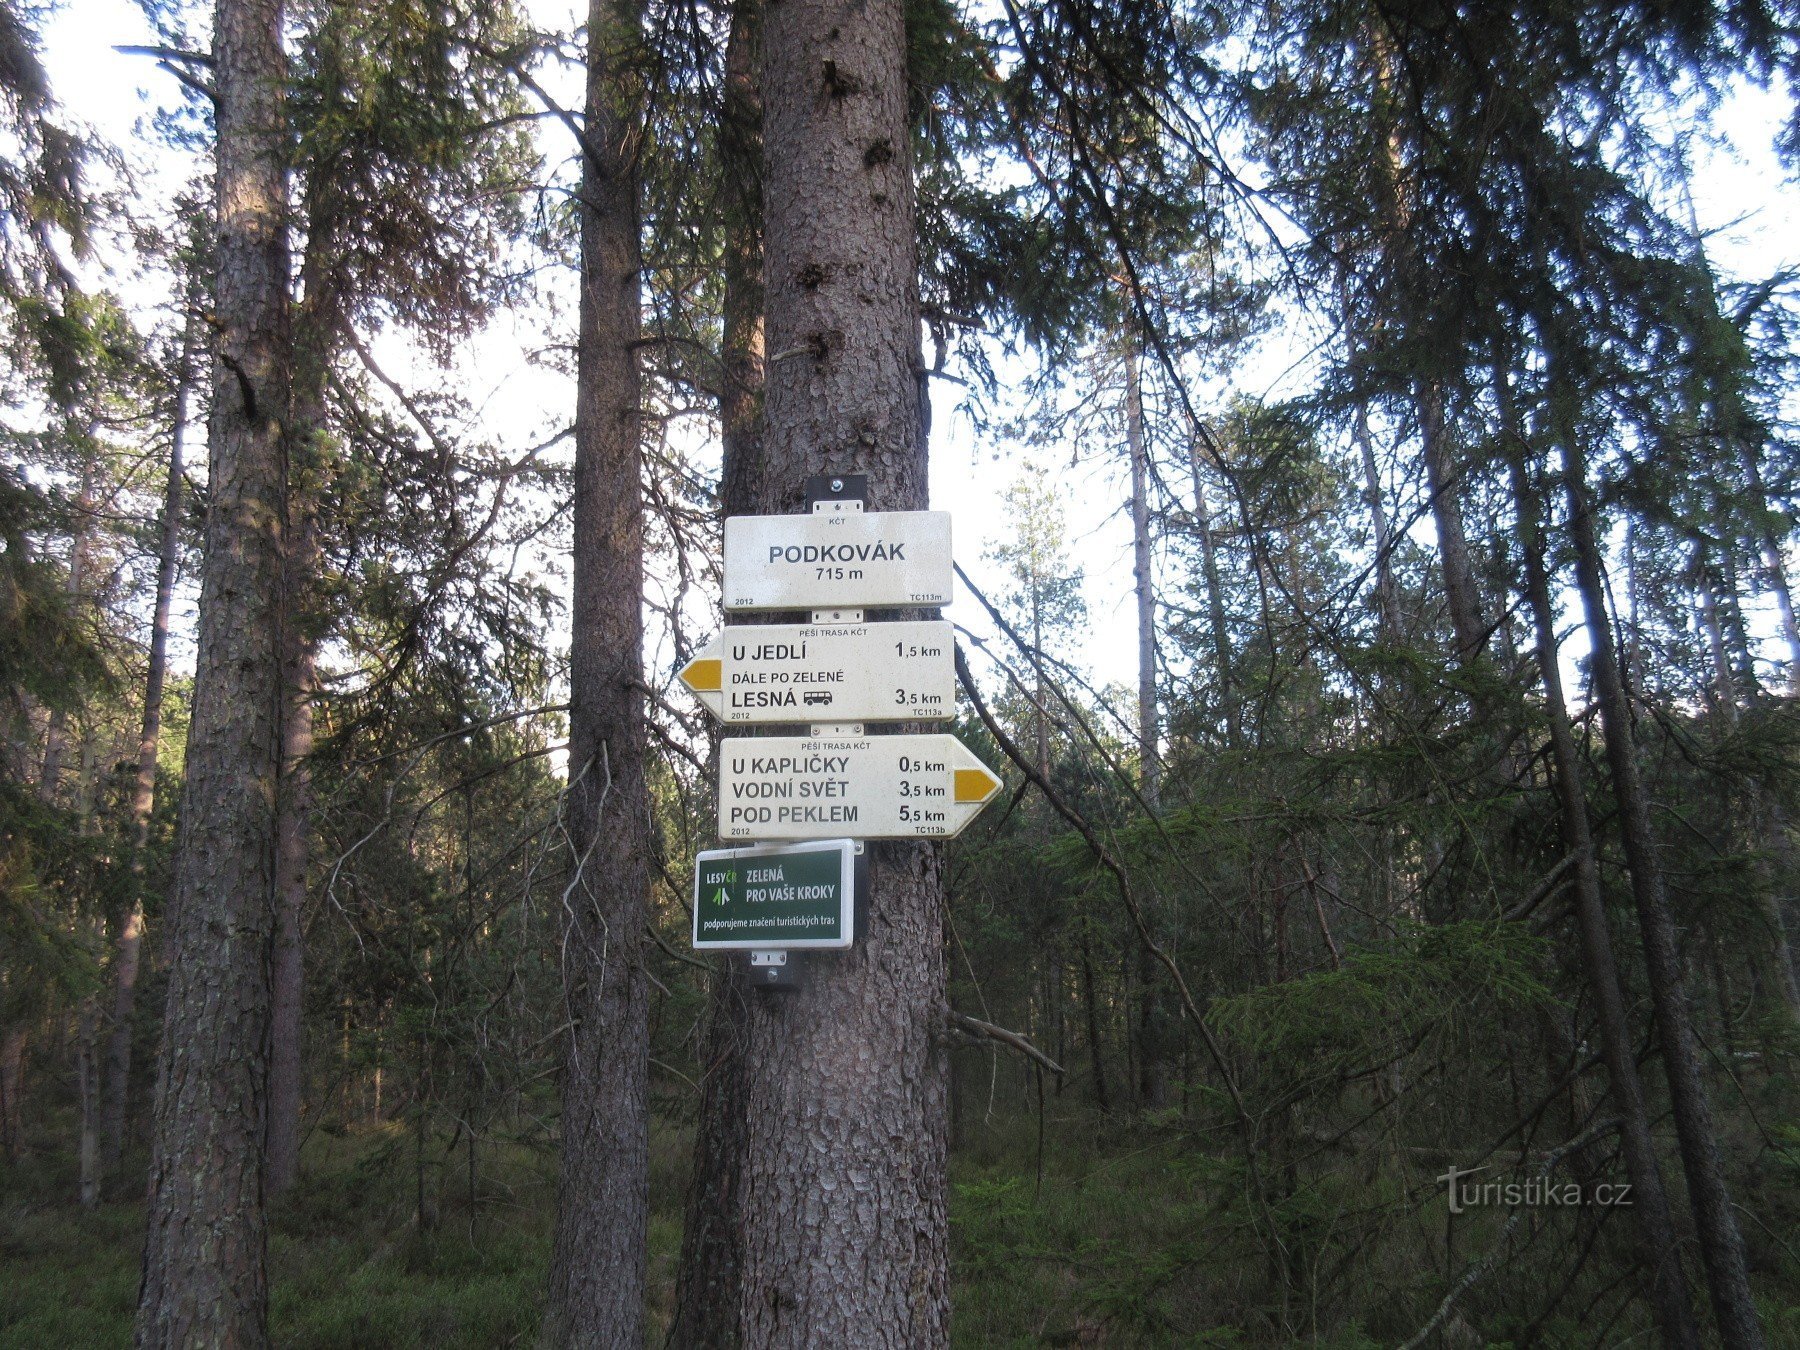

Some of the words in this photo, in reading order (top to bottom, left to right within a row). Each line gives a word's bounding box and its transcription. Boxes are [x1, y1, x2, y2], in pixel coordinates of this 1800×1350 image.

[829, 517, 846, 525] KČT
[769, 540, 905, 563] PODKOVÁK
[816, 568, 844, 580] 715
[849, 570, 863, 580] m
[910, 593, 942, 601] TC113m
[800, 629, 818, 637] PĚŠÍ
[851, 628, 868, 636] KČT
[733, 646, 746, 660] U
[752, 641, 806, 660] JEDLÍ
[895, 642, 917, 659] 1,5
[922, 646, 941, 657] km
[732, 671, 766, 684] DÁLE
[771, 673, 789, 683] PO
[793, 669, 844, 683] ZELENÉ
[732, 688, 797, 707] LESNÁ
[895, 689, 917, 705] 3,5
[922, 693, 941, 704] km
[731, 712, 750, 720] 2012
[913, 708, 942, 716] TC113a
[854, 742, 871, 750] KČT
[732, 759, 745, 774] U
[752, 754, 849, 774] KAPLIČKY
[899, 757, 922, 773] 0,5
[925, 761, 945, 772] km
[732, 779, 793, 798] VODNÍ
[799, 778, 849, 797] SVĚT
[899, 781, 922, 798] 3,5
[925, 786, 945, 797] km
[731, 807, 772, 823] POD
[779, 806, 858, 822] PEKLEM
[899, 806, 922, 823] 5,5
[925, 810, 945, 821] km
[746, 865, 784, 883] ZELENÁ
[746, 889, 767, 902] PRO
[769, 884, 794, 901] VAŠE
[798, 884, 835, 900] KROKY
[704, 918, 748, 931] podporujeme
[749, 917, 775, 927] značení
[777, 915, 819, 928] turistických
[821, 916, 835, 925] tras
